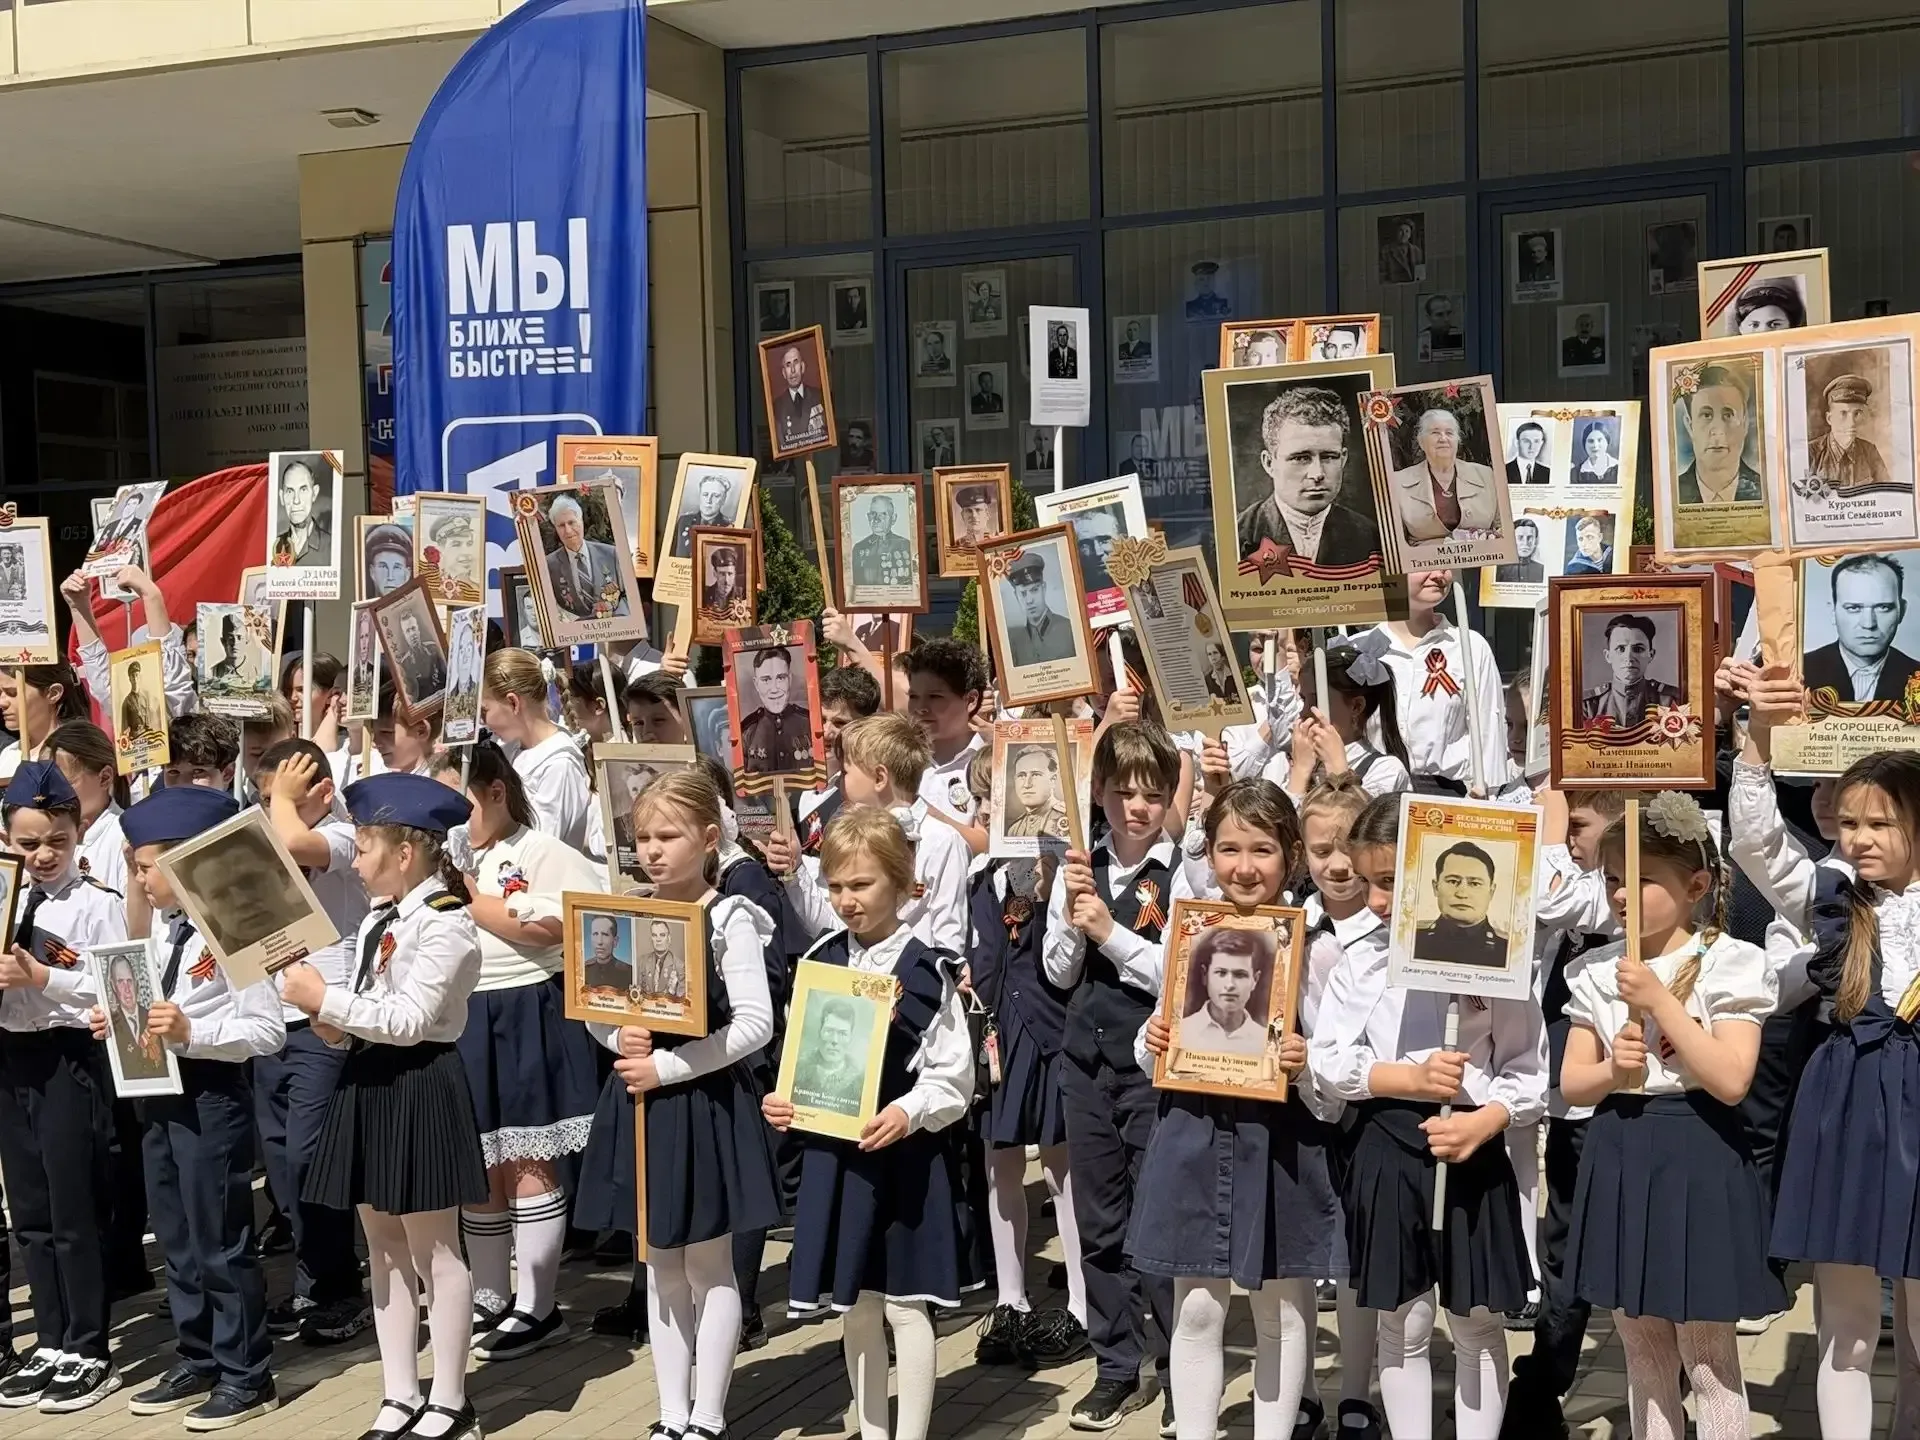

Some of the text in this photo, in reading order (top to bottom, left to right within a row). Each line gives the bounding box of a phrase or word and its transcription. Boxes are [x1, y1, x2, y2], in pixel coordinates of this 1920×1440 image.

[447, 217, 589, 315] МЫ
[449, 316, 545, 348] БЛИЖЕ
[267, 380, 302, 391] ГОРОДА
[246, 403, 291, 416] ИМЕНИ
[1828, 499, 1877, 510] Курочкин
[1804, 509, 1902, 522] Василий Семёнович
[1437, 544, 1474, 555] МАЛЯР
[1411, 552, 1504, 568] Татьяна Ивановна
[302, 570, 338, 579] ДУДАРОВ
[271, 578, 338, 587] Алексей Степанович
[268, 590, 337, 598] БЕССМЕРТНЫЙ ПОЛК
[1230, 581, 1399, 600] Муковоз Александр Петрович
[1297, 594, 1330, 603] рядовой
[1272, 603, 1356, 616] БЕССМЕРТНЫЙ ПОЛК
[582, 620, 613, 631] МАЛЯР
[558, 627, 640, 644] Петр Спиридонович
[1824, 722, 1901, 734] СКОРОЩЕКА
[1809, 732, 1916, 744] Иван Аксентьевич
[1586, 760, 1672, 769] Михаил Иванович
[1455, 814, 1515, 825] БЕССМЕРТНЫЙ
[1457, 821, 1512, 833] ПОЛК РОССИИ
[1401, 966, 1438, 977] Джакупов
[1439, 970, 1473, 980] Апсаттар
[1185, 1051, 1258, 1068] Николай Кузнецов
[821, 1091, 859, 1106] Константин
